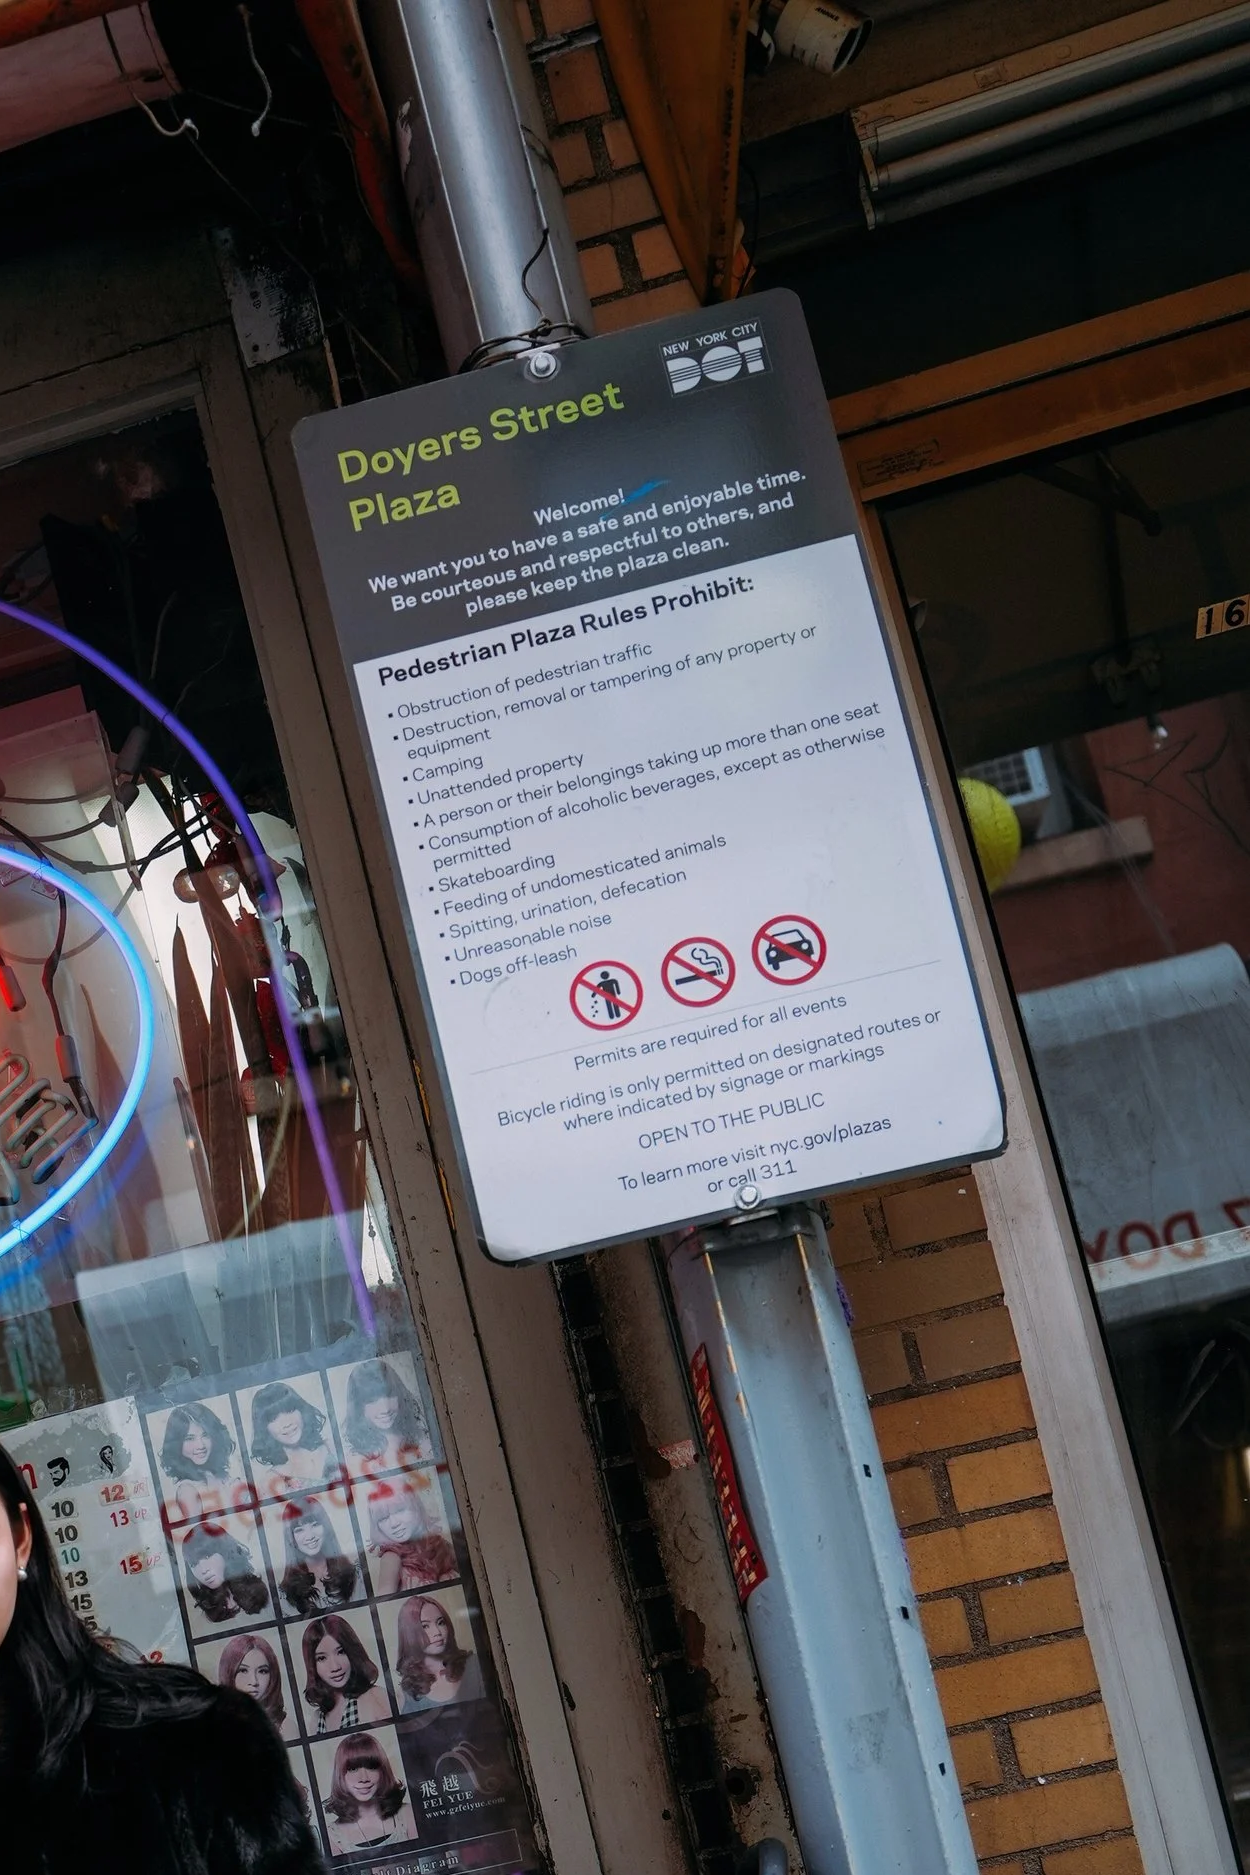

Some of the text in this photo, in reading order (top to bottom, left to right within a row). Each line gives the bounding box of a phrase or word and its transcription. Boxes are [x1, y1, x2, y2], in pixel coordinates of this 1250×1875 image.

[661, 321, 759, 358] NEW YORK CITY
[665, 334, 766, 395] DOT
[337, 382, 623, 483] Doyers Street
[348, 482, 461, 531] Plaza
[366, 469, 807, 595] We want you to have a safe and enjoyable time.
[532, 487, 626, 527] Welcome!
[389, 490, 796, 613] Be courteous and respectful to others, and
[464, 535, 731, 619] please keep the plaza clean.
[376, 575, 755, 688] Pedestrian Plaza Rules Prohibit:
[1205, 599, 1247, 635] 16
[396, 642, 654, 720] Obstruction of pedestrian traffic
[401, 624, 818, 743] Destruction, removal or tampering of any property or
[406, 727, 493, 761] equipment
[411, 754, 485, 783] Camping
[422, 700, 882, 830] A person or their belongings taking up more than one seat
[415, 752, 585, 806] Unattended property
[427, 726, 887, 852] Consumption of alcoholic beverages, except as otherwise
[432, 835, 513, 874] permitted
[437, 853, 557, 894] Skateboarding
[441, 833, 728, 917] Feeding of undomesticated animals
[448, 869, 688, 941] Spitting, urination, defecation
[452, 913, 613, 963] Unreasonable noise
[458, 944, 579, 987] Dogs off-leash
[572, 995, 848, 1072] Permits are required for all events
[496, 1009, 942, 1128] Bicycle riding is only permitted on designated routes or
[562, 1044, 886, 1132] where indicated by signage or markings
[637, 1091, 826, 1151] OPEN TO THE PUBLIC
[616, 1117, 893, 1192] To learn more visit nyc.gov/plazas
[706, 1158, 799, 1194] or call 311
[51, 1500, 75, 1518] 10
[101, 1484, 126, 1504] 12
[54, 1524, 79, 1545] 10
[110, 1509, 130, 1528] 13
[61, 1547, 81, 1565] 10
[64, 1570, 89, 1589] 13
[119, 1554, 143, 1576] 15
[84, 1615, 98, 1632] 5
[422, 1790, 475, 1811] FEI YUE
